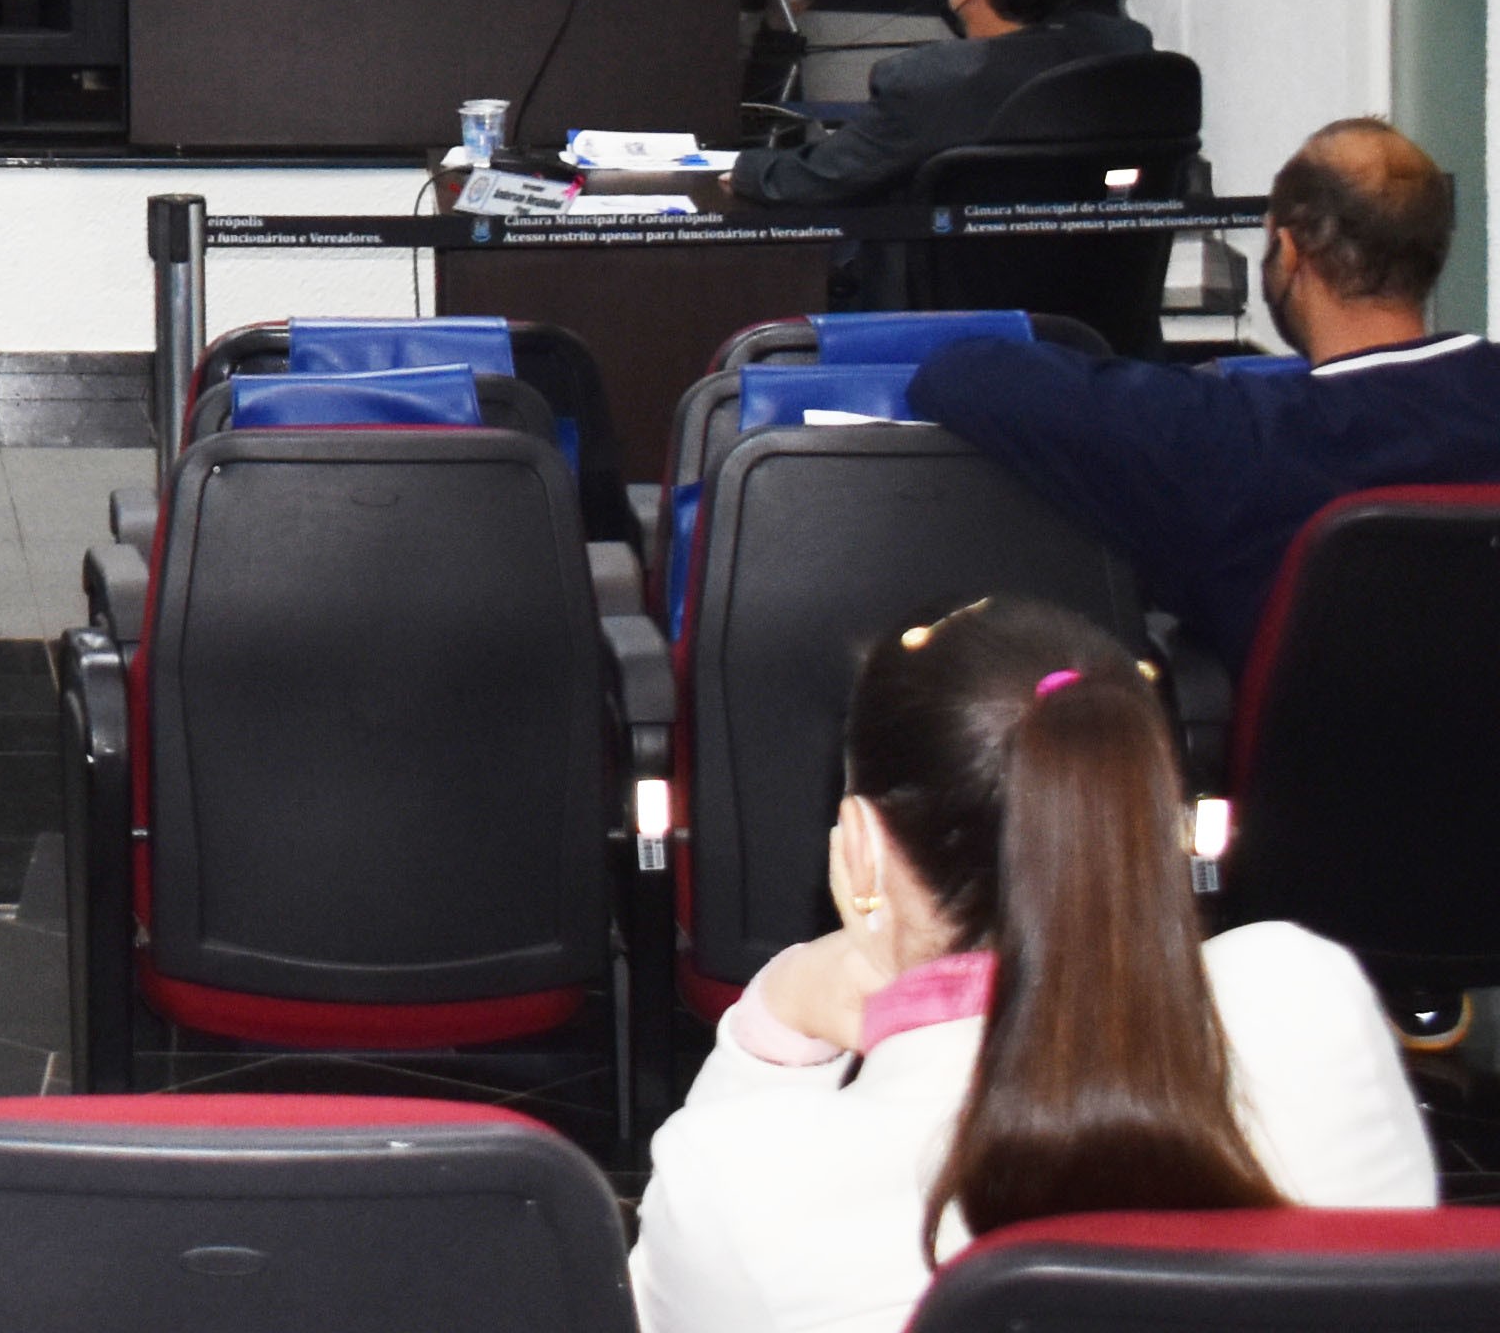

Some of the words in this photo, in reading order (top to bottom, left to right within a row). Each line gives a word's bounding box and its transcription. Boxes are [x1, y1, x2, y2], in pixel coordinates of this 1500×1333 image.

[964, 203, 1012, 216] Câmara
[1015, 202, 1077, 216] Municipal
[1080, 201, 1095, 213] de
[1098, 199, 1184, 215] Cordeirópolis
[504, 213, 551, 226] Câmara
[555, 213, 616, 228] Municipal
[619, 213, 634, 225] de
[638, 211, 723, 226] Cordeirópolis
[963, 221, 1007, 233] Acesso
[1009, 220, 1058, 232] restrito
[1061, 220, 1105, 232] apenas
[1108, 220, 1136, 231] para
[1139, 215, 1218, 228] funcionários
[217, 232, 296, 244] funcionários
[310, 232, 383, 244] Vereadores.
[503, 231, 546, 243] Acesso
[549, 230, 596, 242] restrito
[599, 232, 642, 245] apenas
[646, 233, 674, 244] para
[677, 228, 757, 241] funcionários
[770, 226, 844, 238] Vereadores.
